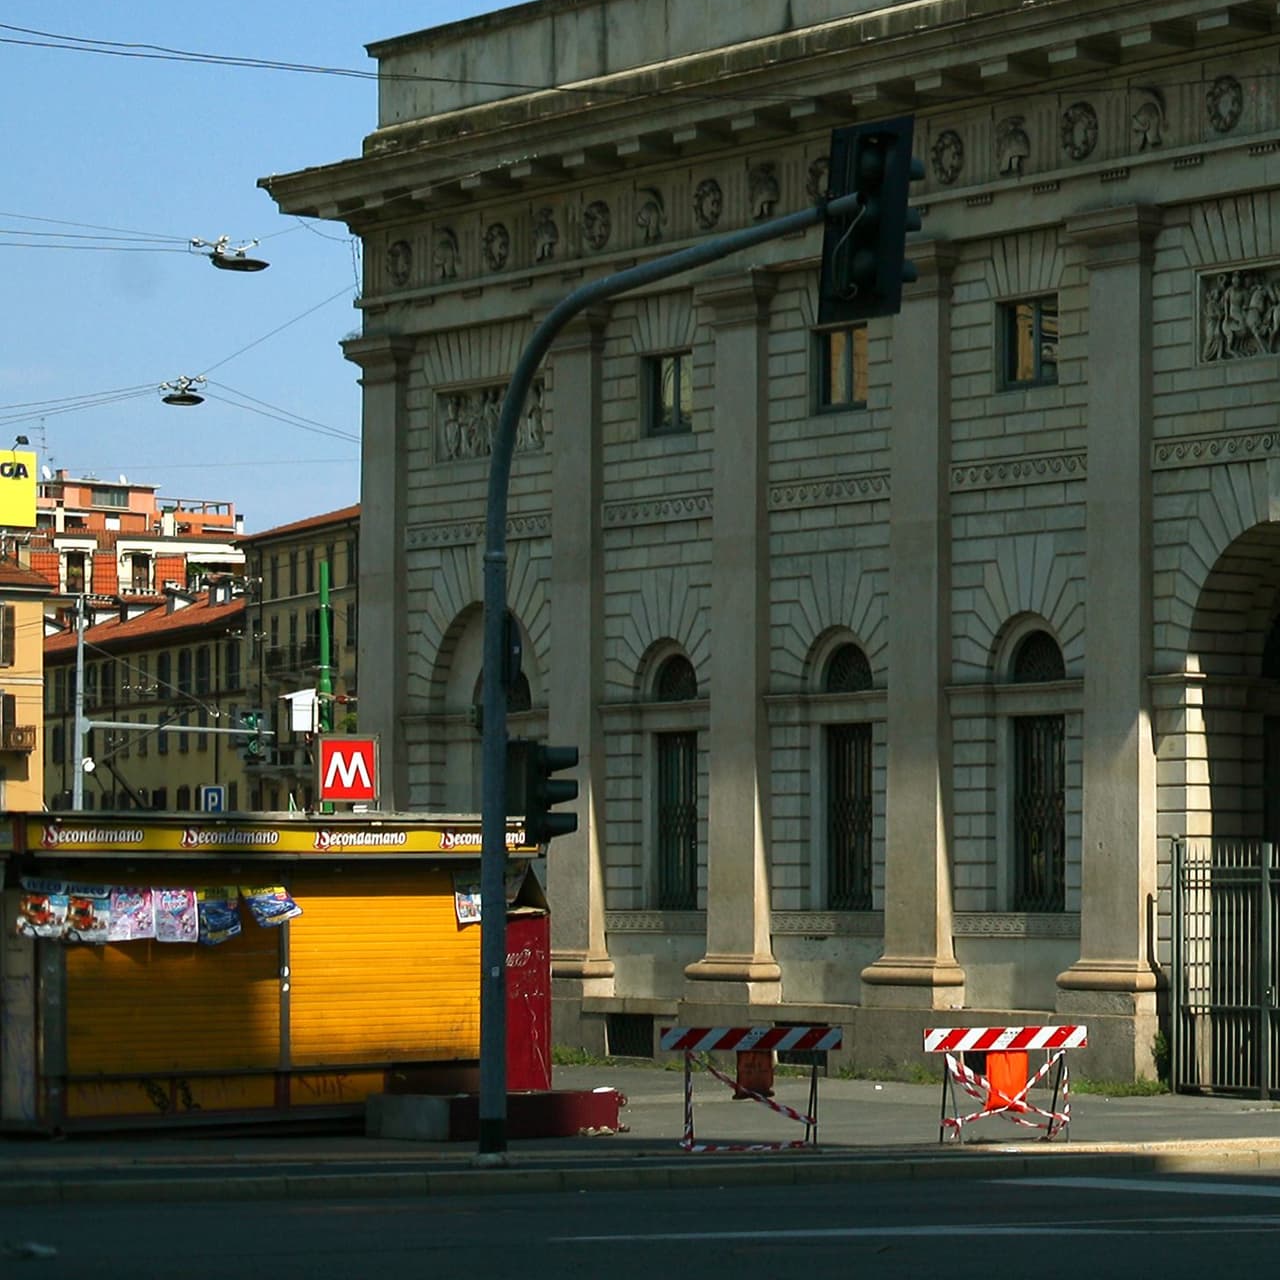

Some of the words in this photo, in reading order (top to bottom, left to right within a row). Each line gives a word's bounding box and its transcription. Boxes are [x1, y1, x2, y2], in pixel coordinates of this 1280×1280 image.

[324, 751, 372, 788] M
[208, 792, 219, 811] P
[42, 827, 144, 848] Secondamano
[180, 828, 280, 848] Secondamano
[314, 830, 406, 849] Secondamano
